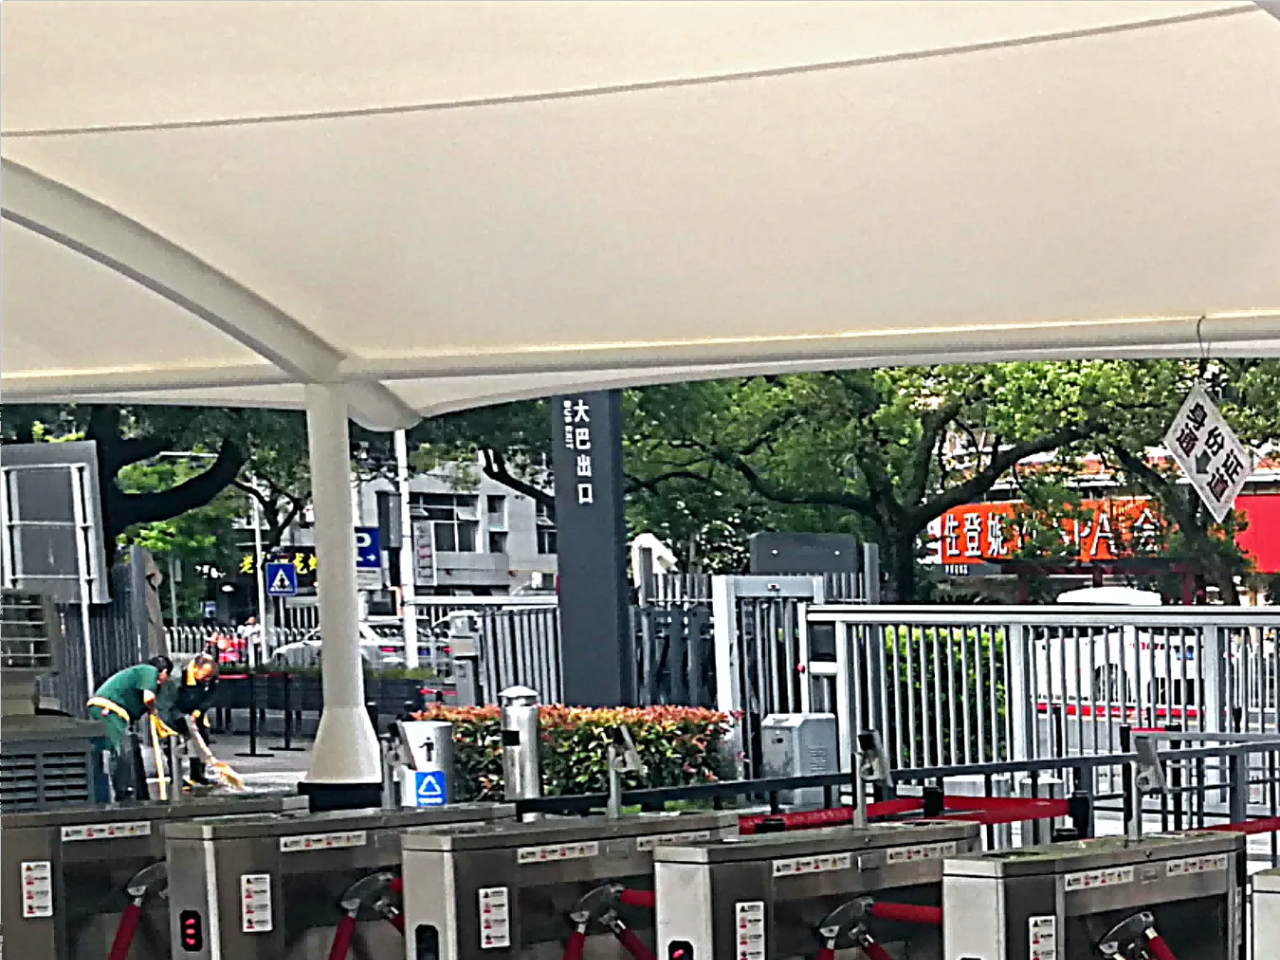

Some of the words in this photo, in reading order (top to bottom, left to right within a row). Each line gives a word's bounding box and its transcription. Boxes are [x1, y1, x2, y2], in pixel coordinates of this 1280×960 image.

[573, 399, 593, 504] 大巴出口
[1187, 402, 1244, 484] 身份证
